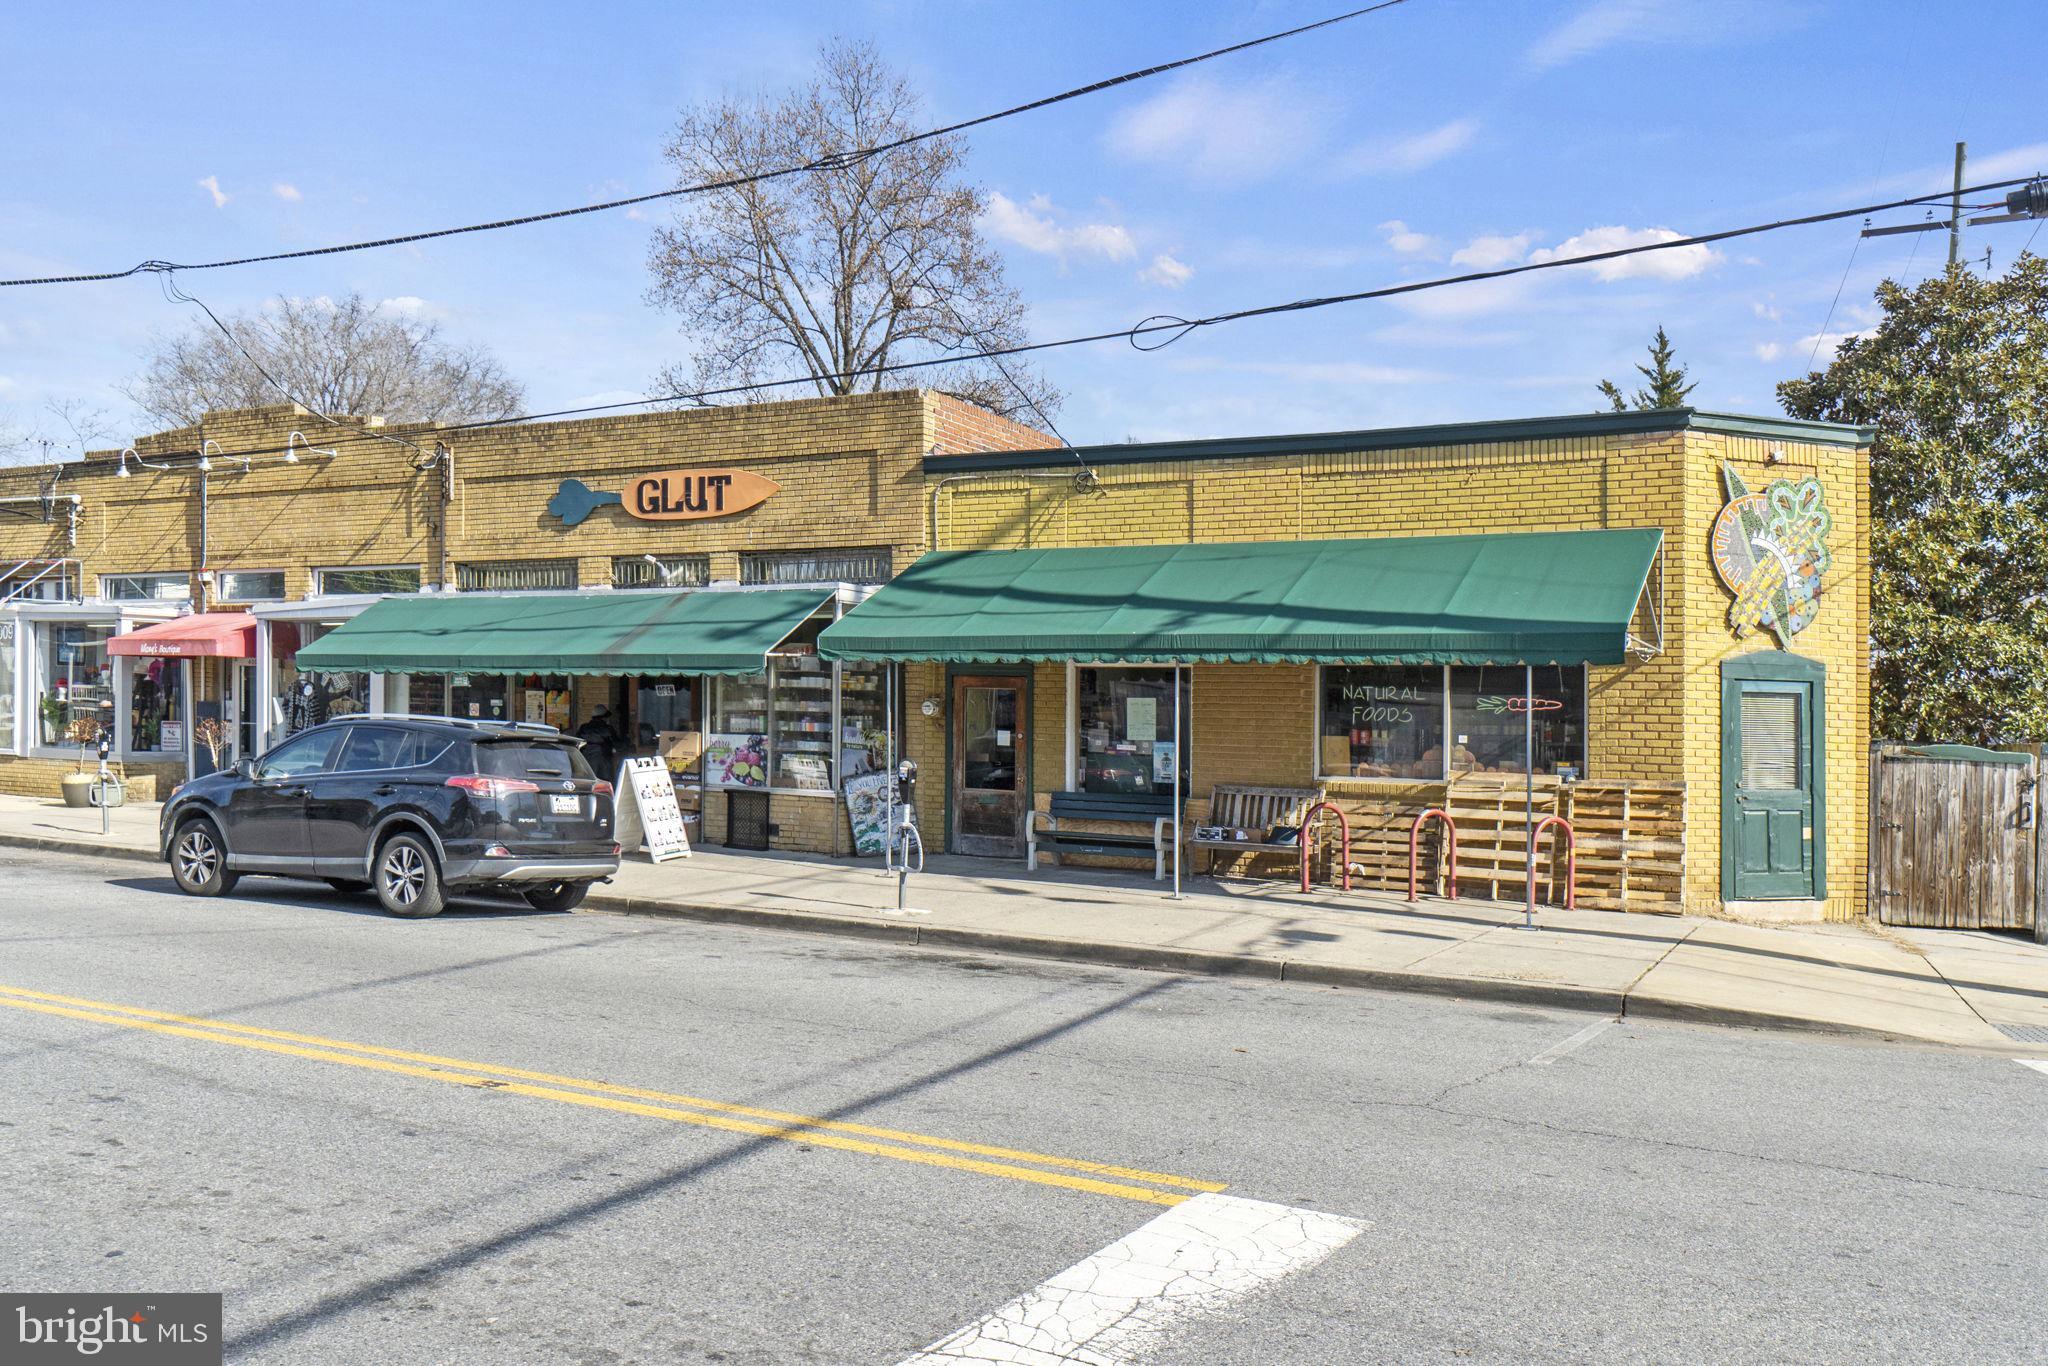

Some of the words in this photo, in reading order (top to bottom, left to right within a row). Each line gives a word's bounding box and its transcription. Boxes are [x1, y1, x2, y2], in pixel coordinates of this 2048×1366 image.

[637, 474, 732, 515] GLUT
[657, 685, 675, 695] OPEN
[1343, 684, 1426, 702] NATURAL
[1352, 706, 1413, 725] FOODS
